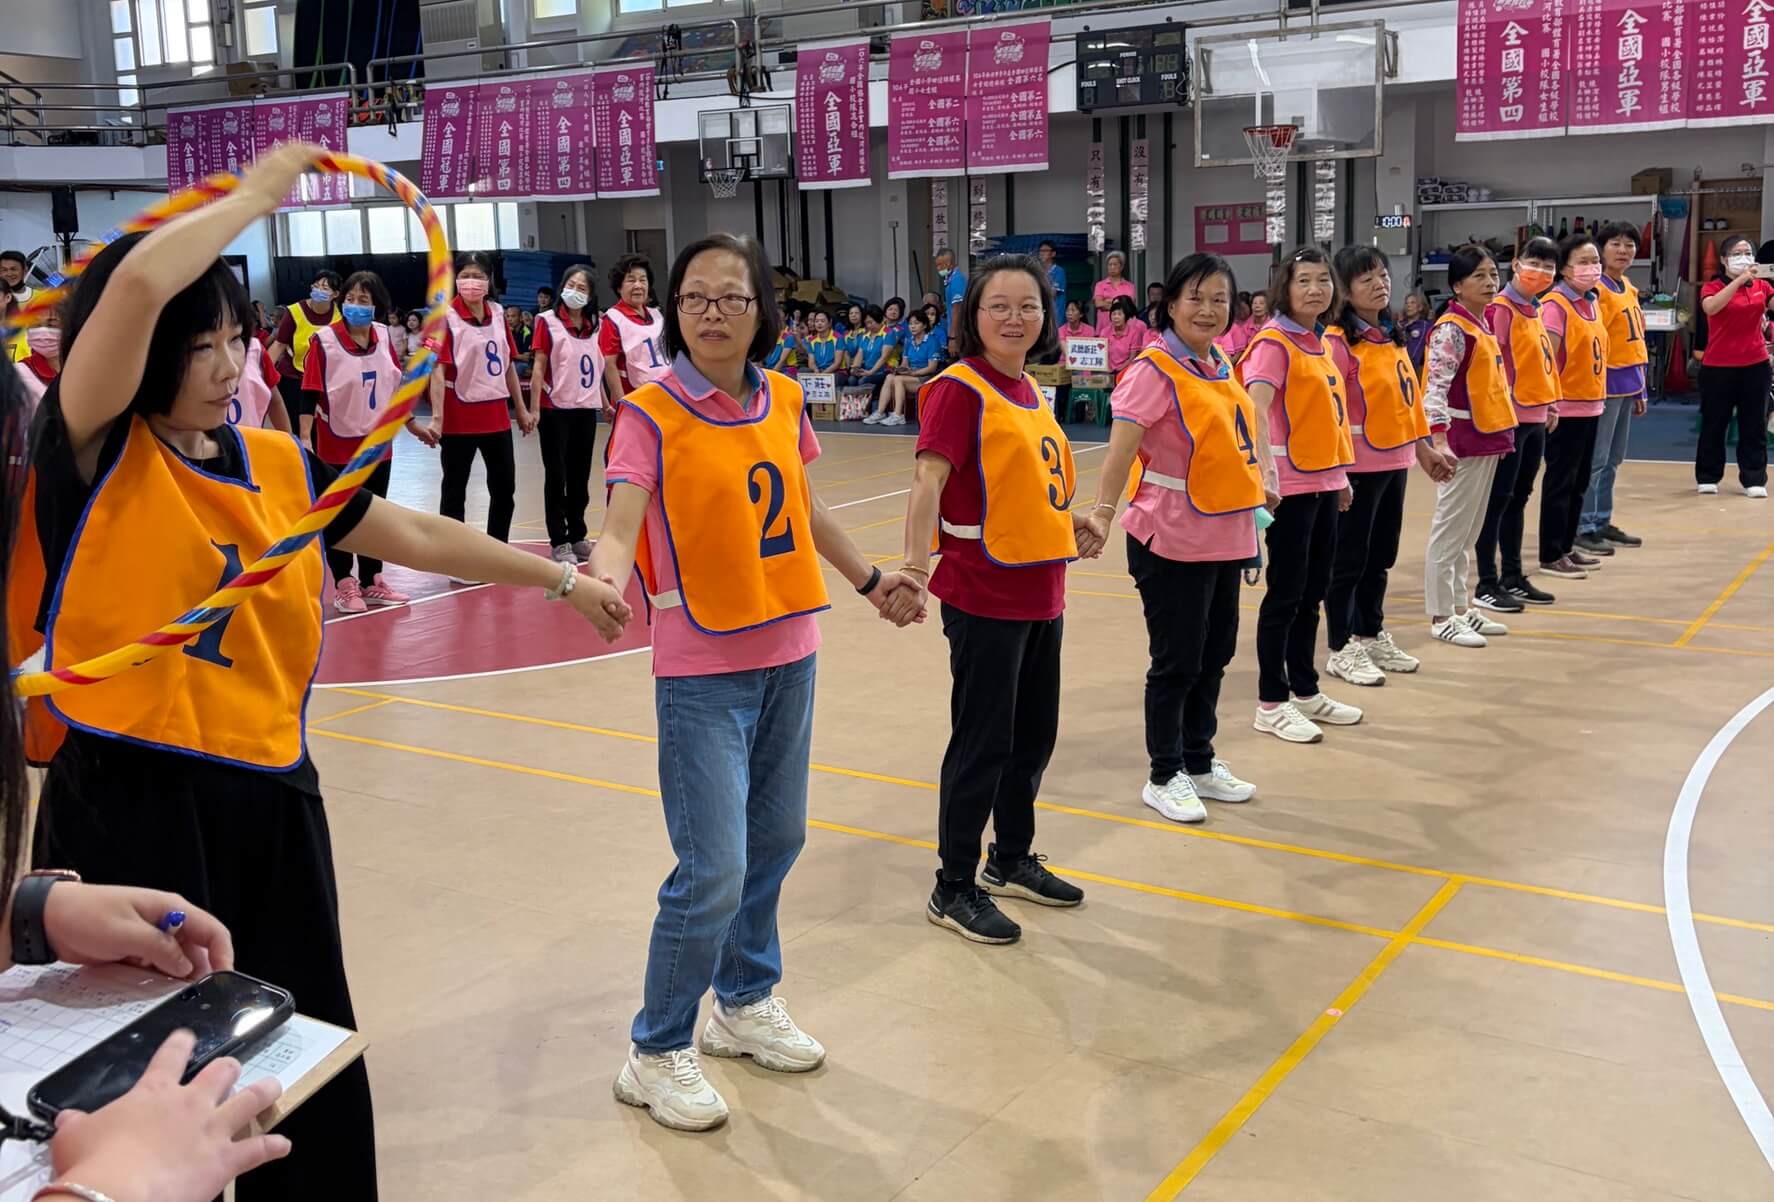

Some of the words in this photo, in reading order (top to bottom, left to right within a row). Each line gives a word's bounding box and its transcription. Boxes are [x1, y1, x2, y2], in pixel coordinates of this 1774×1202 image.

[1500, 21, 1529, 122] 全國第四
[1616, 8, 1648, 117] 全國亞軍
[1739, 0, 1774, 109] 全國亞軍
[497, 120, 512, 191] 全國第四
[556, 115, 572, 189] 全國第四
[617, 109, 634, 186] 全國亞軍
[823, 90, 842, 176] 全國亞軍
[361, 370, 377, 411] 7
[485, 340, 502, 377] 8
[579, 354, 595, 389] 9
[1396, 359, 1415, 408] 6
[1541, 334, 1553, 375] 8
[1592, 336, 1603, 375] 9
[1235, 404, 1258, 465] 4
[747, 461, 796, 559] 2
[1041, 436, 1071, 511] 3
[182, 537, 244, 669] 1
